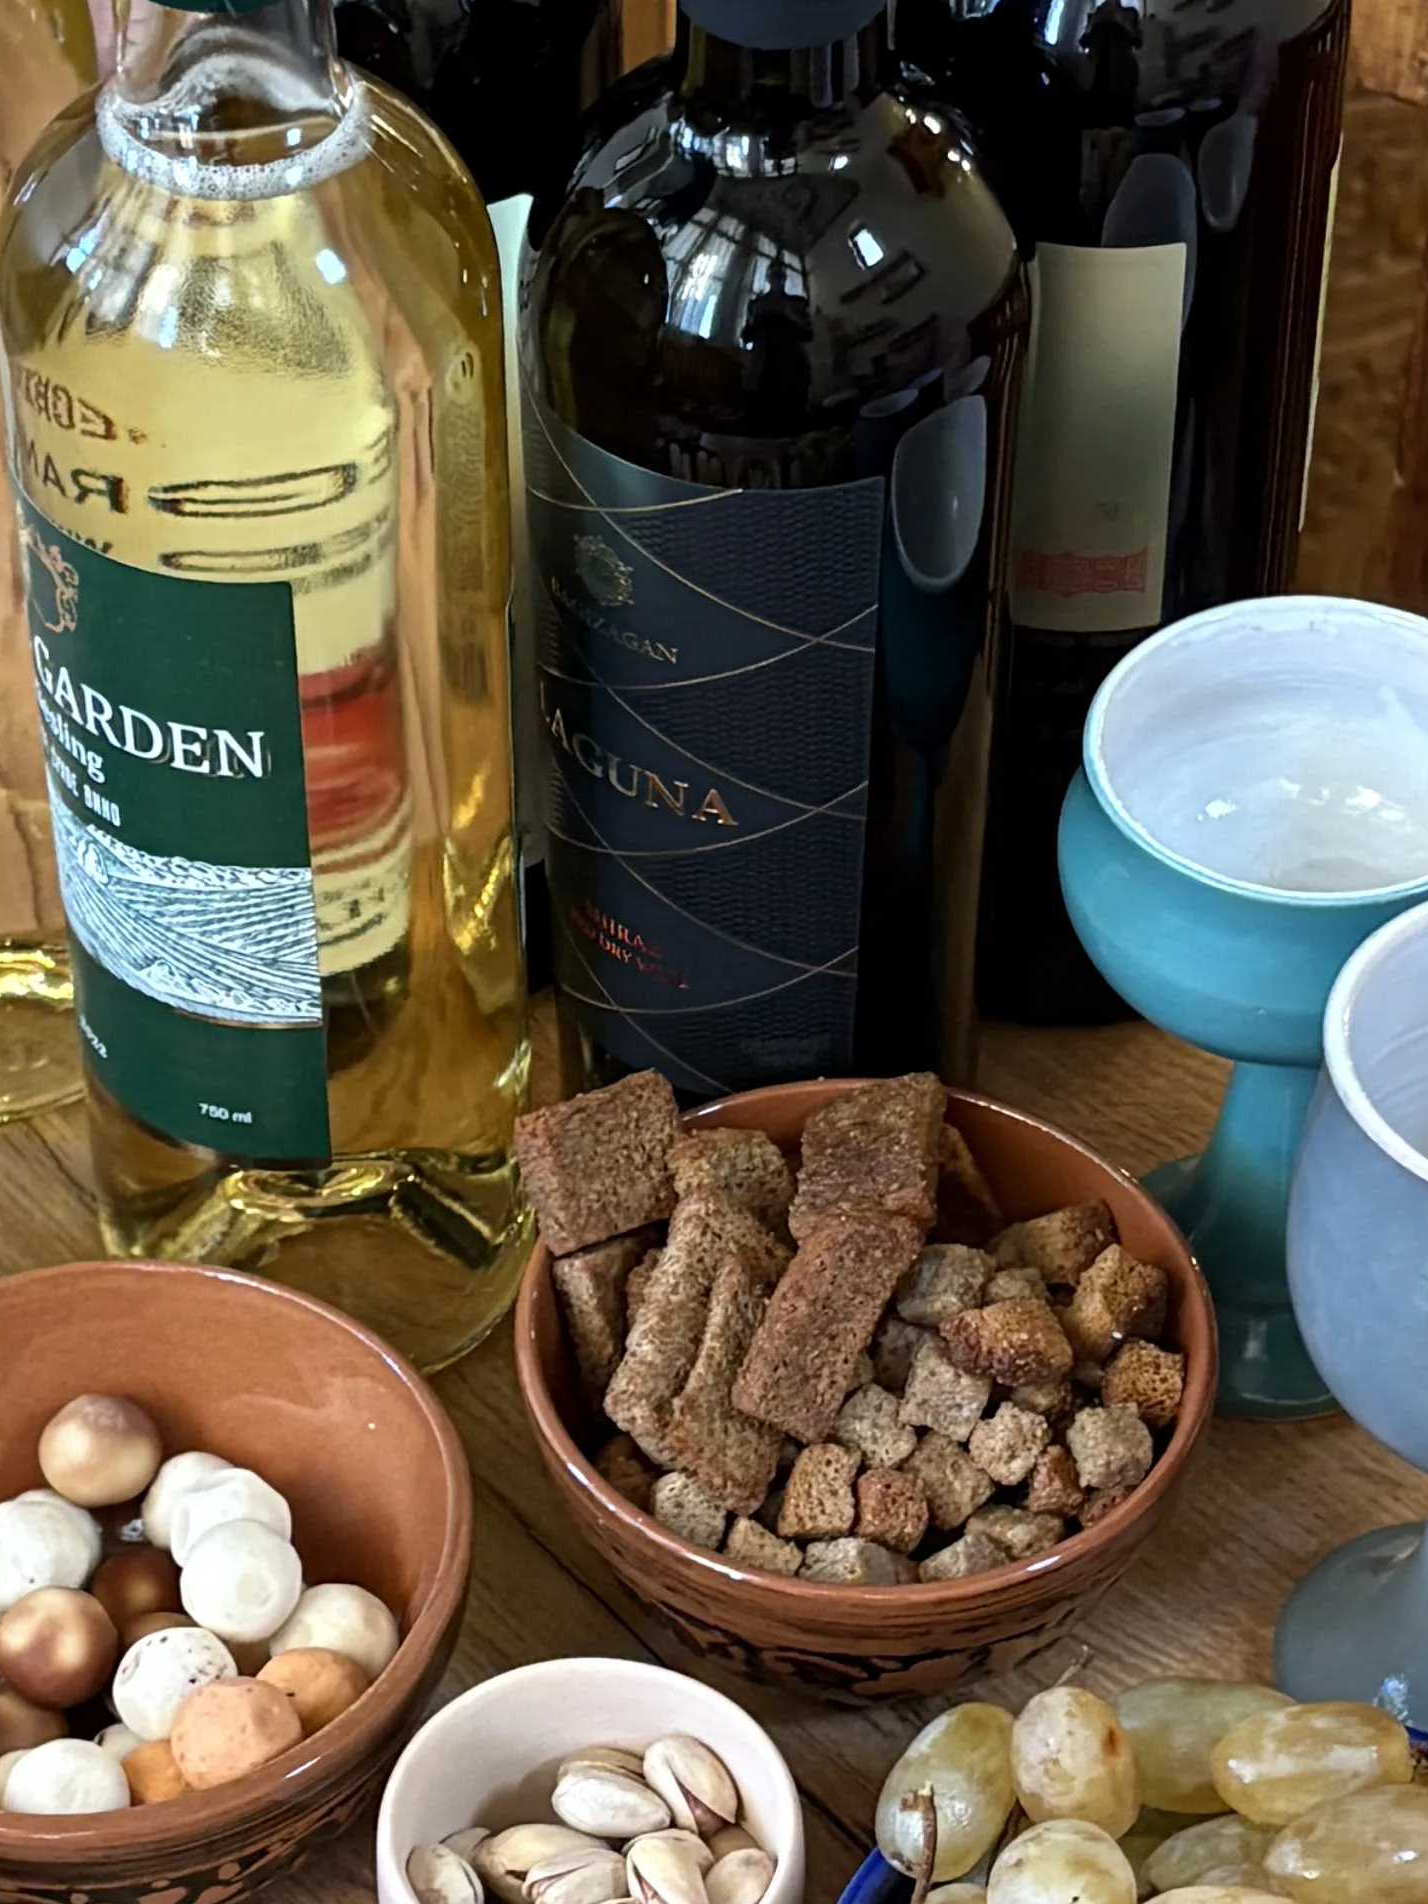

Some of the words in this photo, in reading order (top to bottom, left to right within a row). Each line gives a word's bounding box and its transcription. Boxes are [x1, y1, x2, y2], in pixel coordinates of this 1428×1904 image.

[33, 634, 266, 779] GARDEN
[198, 1101, 230, 1121] 750
[231, 1110, 254, 1125] ml
